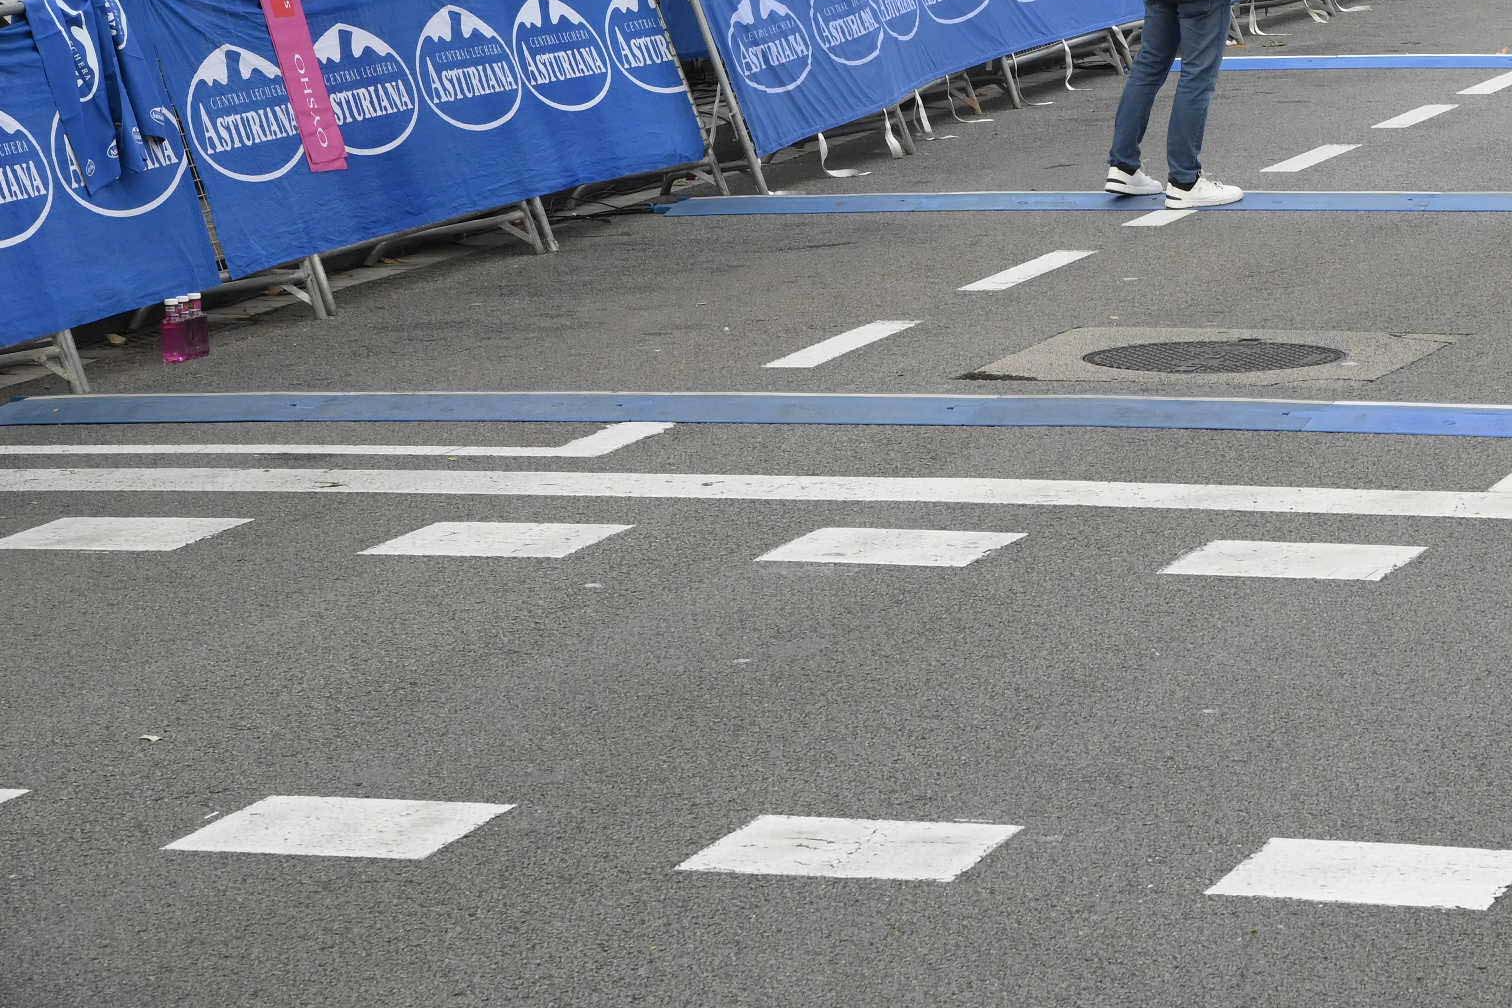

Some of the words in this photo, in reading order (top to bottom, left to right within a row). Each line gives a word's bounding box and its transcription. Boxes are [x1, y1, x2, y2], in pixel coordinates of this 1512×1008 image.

[435, 46, 470, 63] CENTRAL
[472, 42, 502, 59] LECHERA
[528, 33, 558, 48] CENTRAL
[559, 29, 590, 44] LECHERA
[324, 70, 360, 86] CENTRAL
[361, 60, 399, 82] LECHERA
[427, 55, 518, 104] ASTURIANA
[521, 39, 607, 87] ASTURIANA
[210, 89, 248, 110] CENTRAL
[294, 53, 329, 148] OYSHO
[329, 78, 414, 126] STURIANA
[199, 102, 300, 155] ASTURIANA
